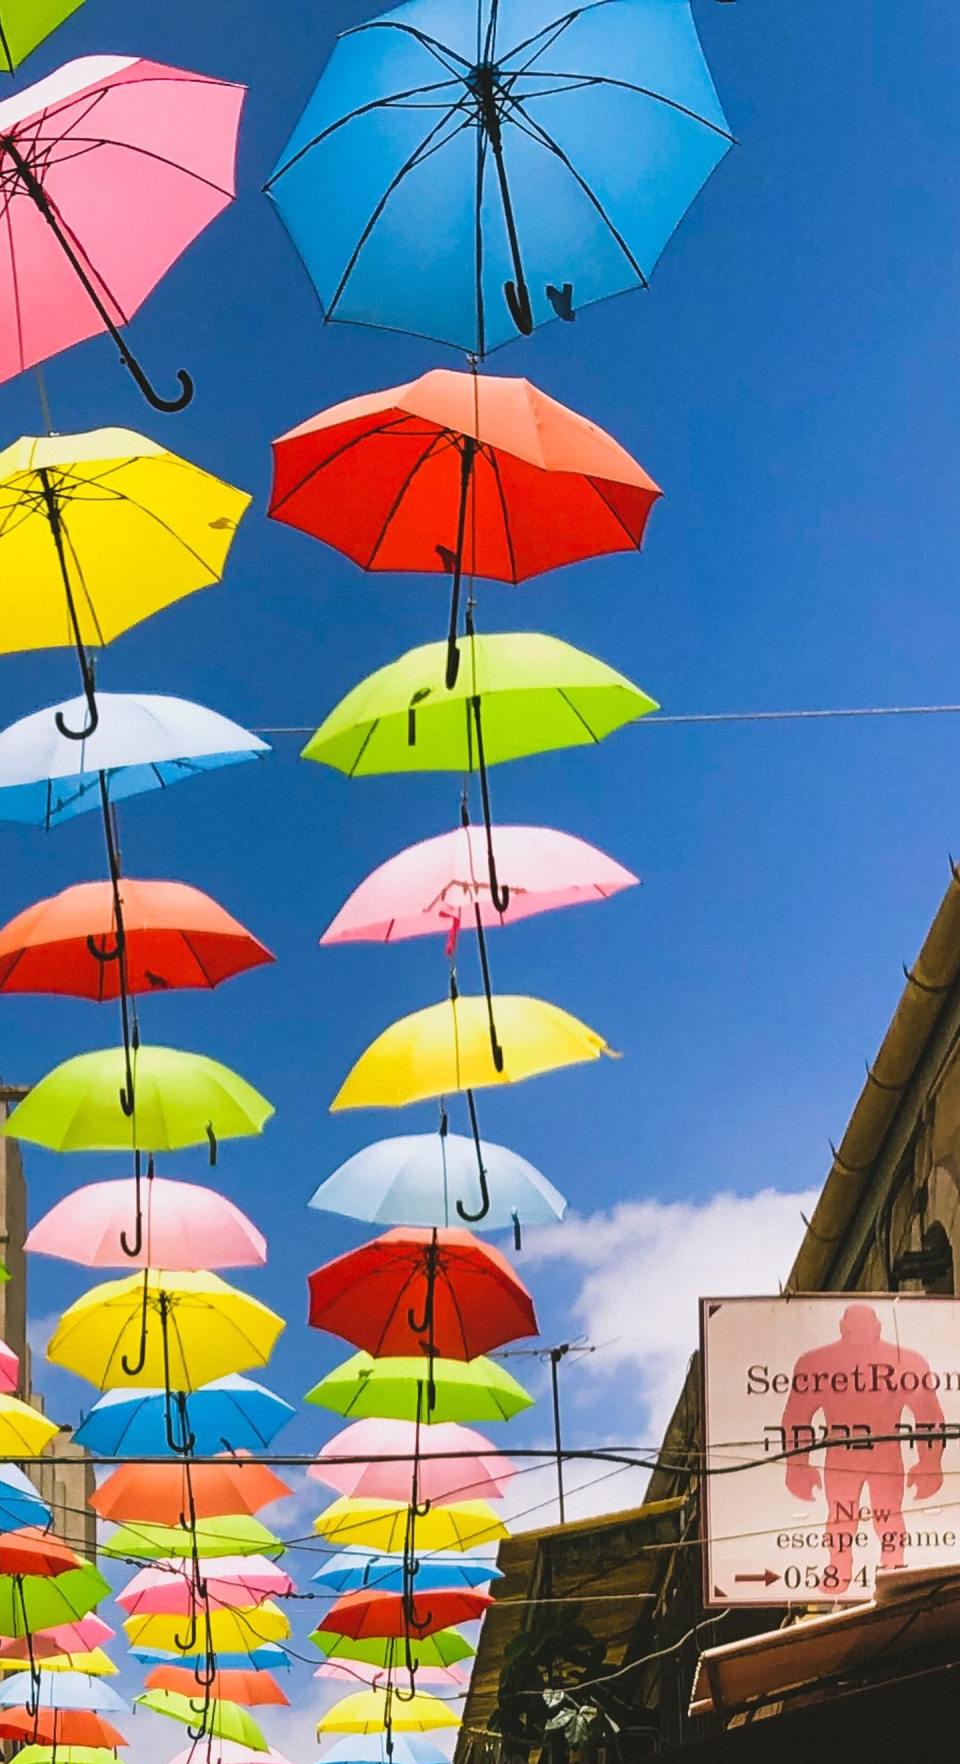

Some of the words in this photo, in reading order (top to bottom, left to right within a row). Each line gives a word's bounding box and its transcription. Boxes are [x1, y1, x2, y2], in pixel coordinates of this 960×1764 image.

[835, 1501, 892, 1523] New
[776, 1530, 868, 1552] escape
[881, 1530, 956, 1552] game
